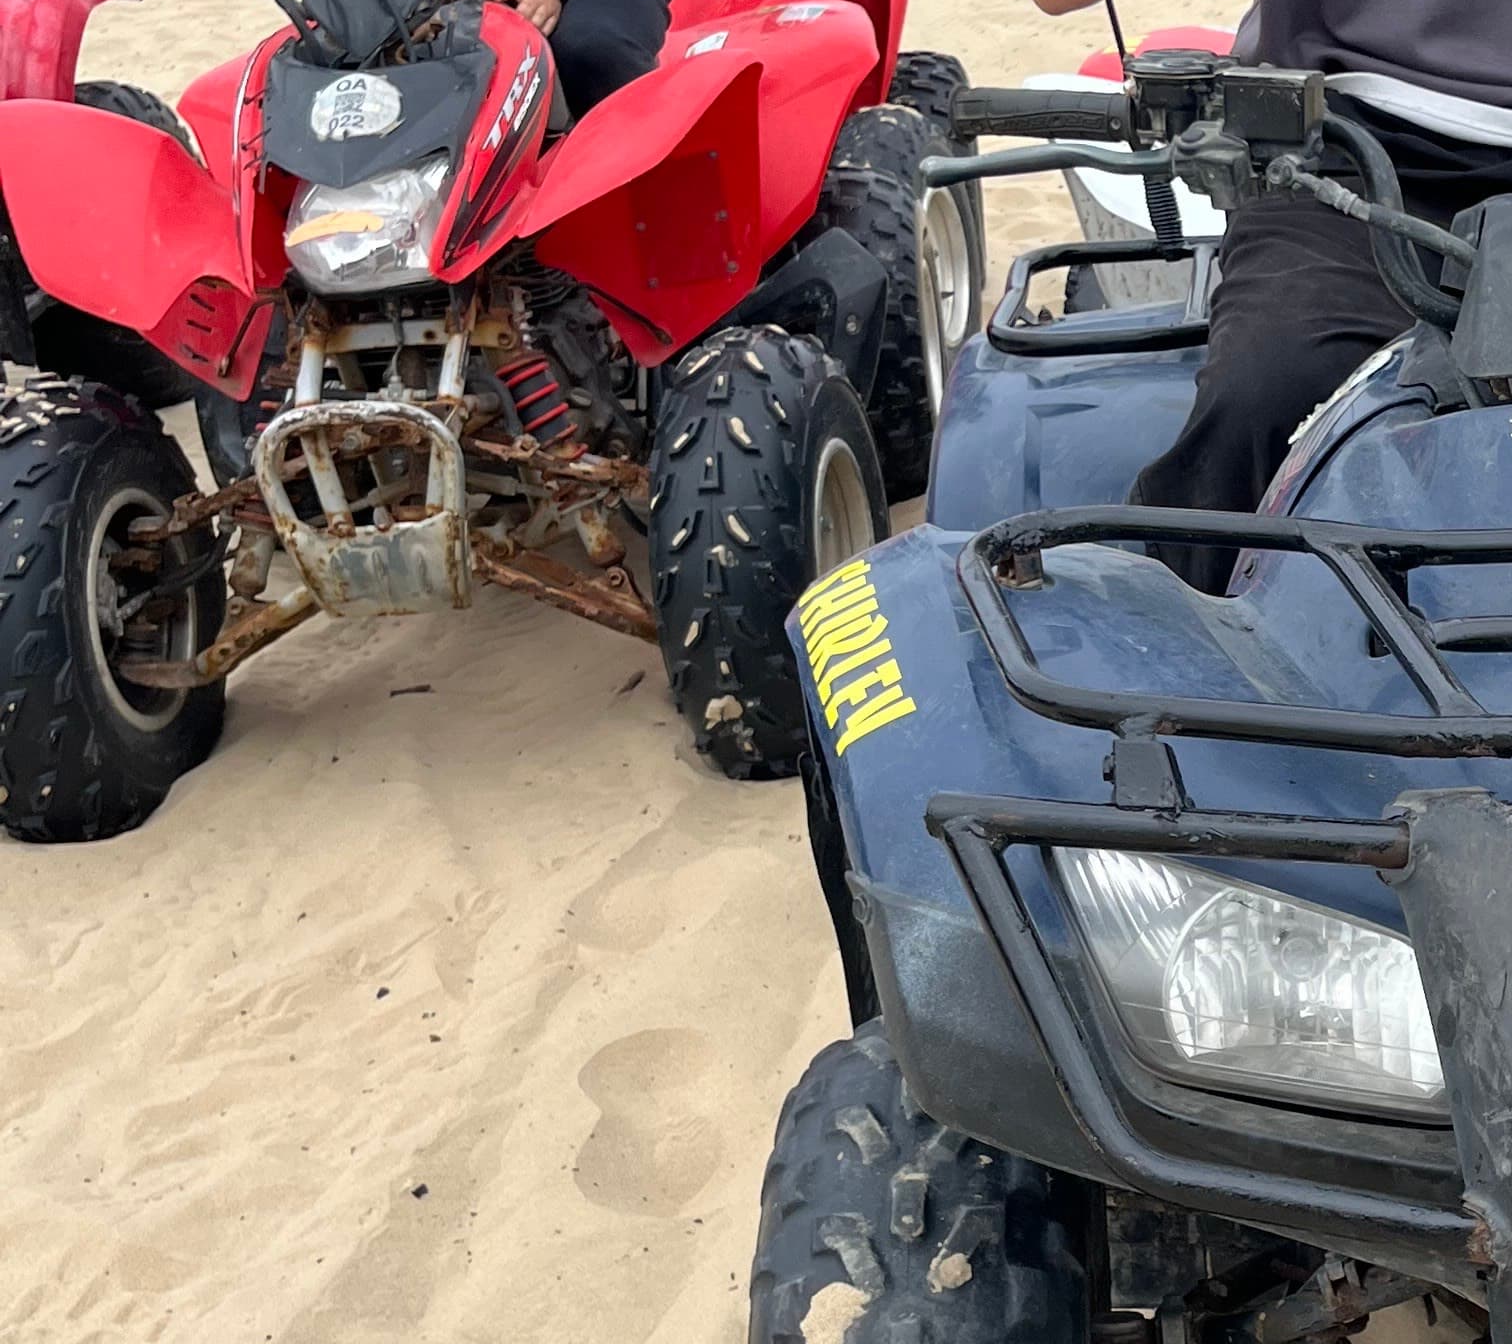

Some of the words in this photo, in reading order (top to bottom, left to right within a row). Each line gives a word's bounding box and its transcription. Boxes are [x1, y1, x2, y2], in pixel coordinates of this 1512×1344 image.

[328, 114, 365, 132] 022
[481, 44, 536, 150] TRX
[798, 559, 917, 757] SHIRLEY
